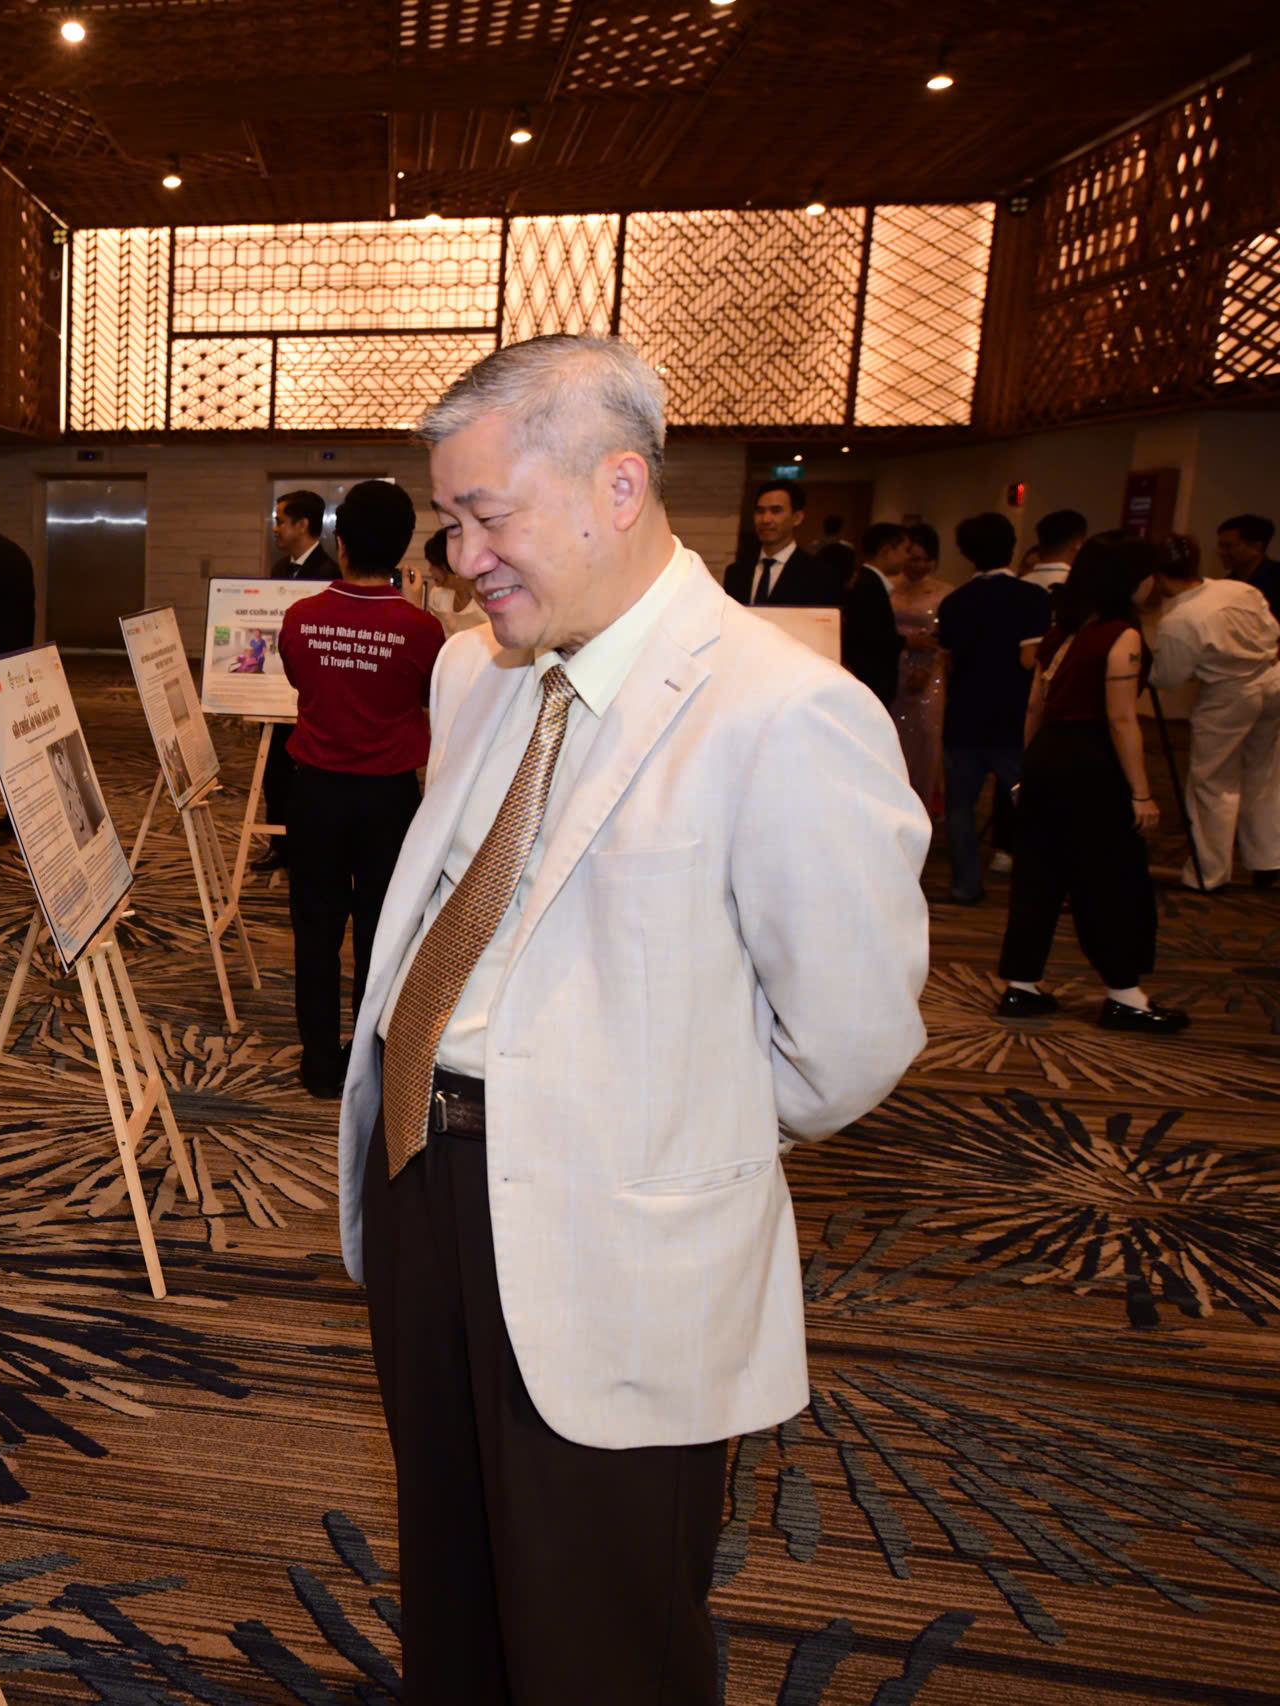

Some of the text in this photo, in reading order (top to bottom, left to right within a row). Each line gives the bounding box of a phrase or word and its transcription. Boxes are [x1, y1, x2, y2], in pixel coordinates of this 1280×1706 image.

[300, 624, 406, 646] Bệnh viện Nhân dân Gia Định
[308, 638, 331, 651] Phòng
[332, 640, 351, 653] Công
[353, 642, 367, 654] Tác
[379, 645, 392, 659] Hội
[356, 658, 378, 673] Thông
